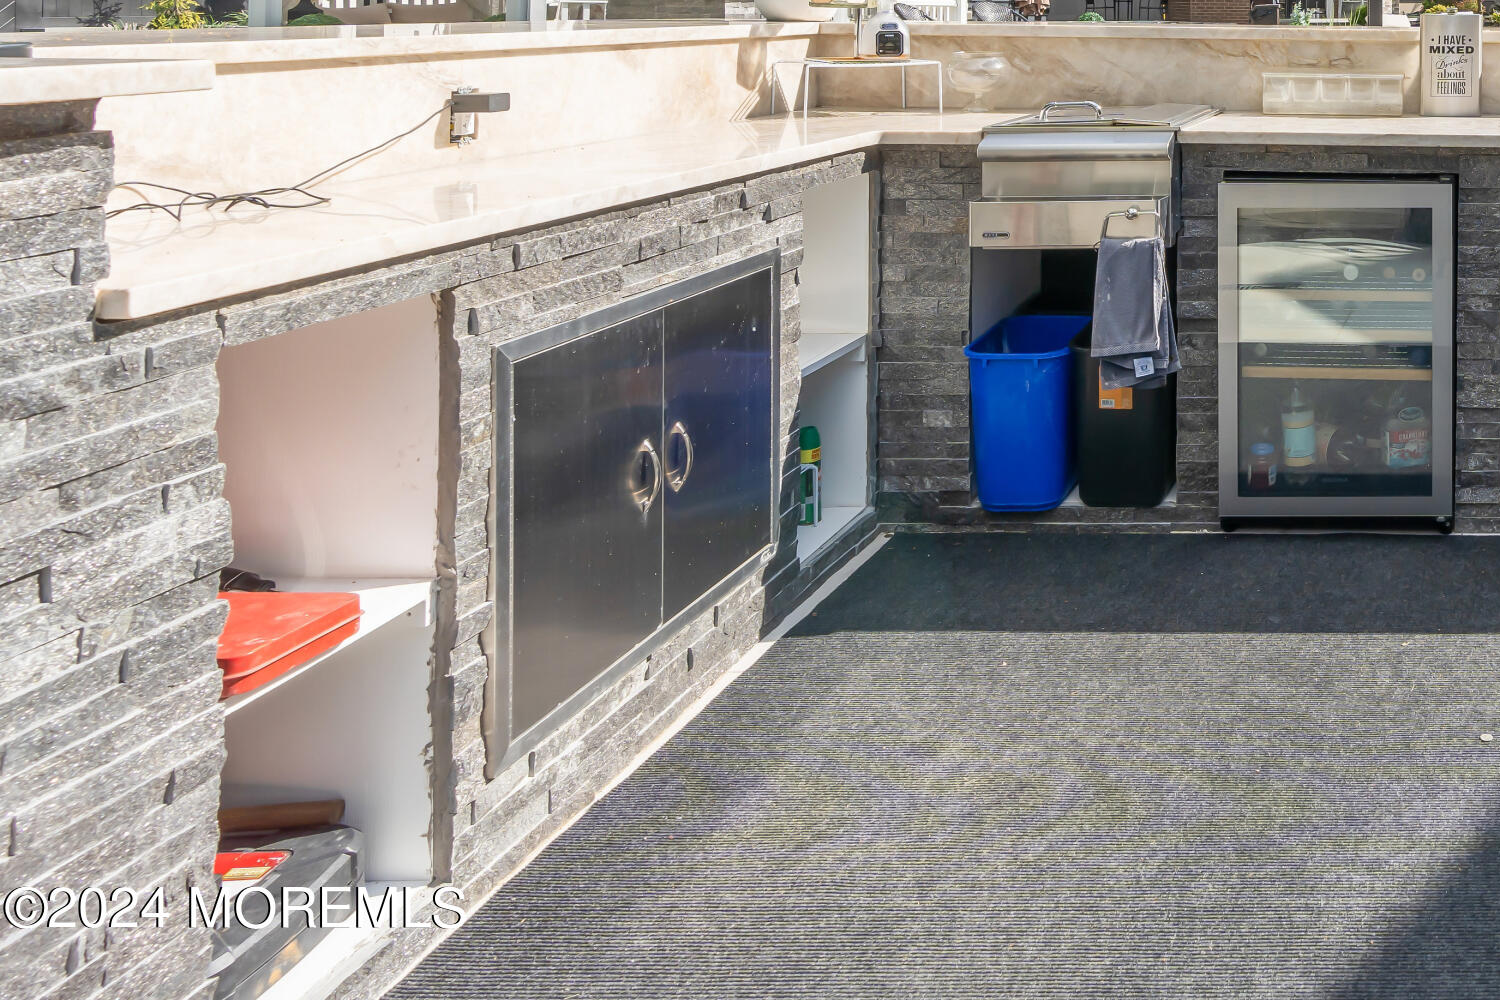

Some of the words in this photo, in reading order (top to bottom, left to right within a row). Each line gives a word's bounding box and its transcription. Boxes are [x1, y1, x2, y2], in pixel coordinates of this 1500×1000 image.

[1438, 35, 1441, 45] I
[1443, 35, 1467, 45] HAVE
[1429, 45, 1475, 54] MIXED
[1435, 55, 1468, 70] Drinks
[1436, 69, 1465, 79] about
[1436, 81, 1466, 95] FEELINGS
